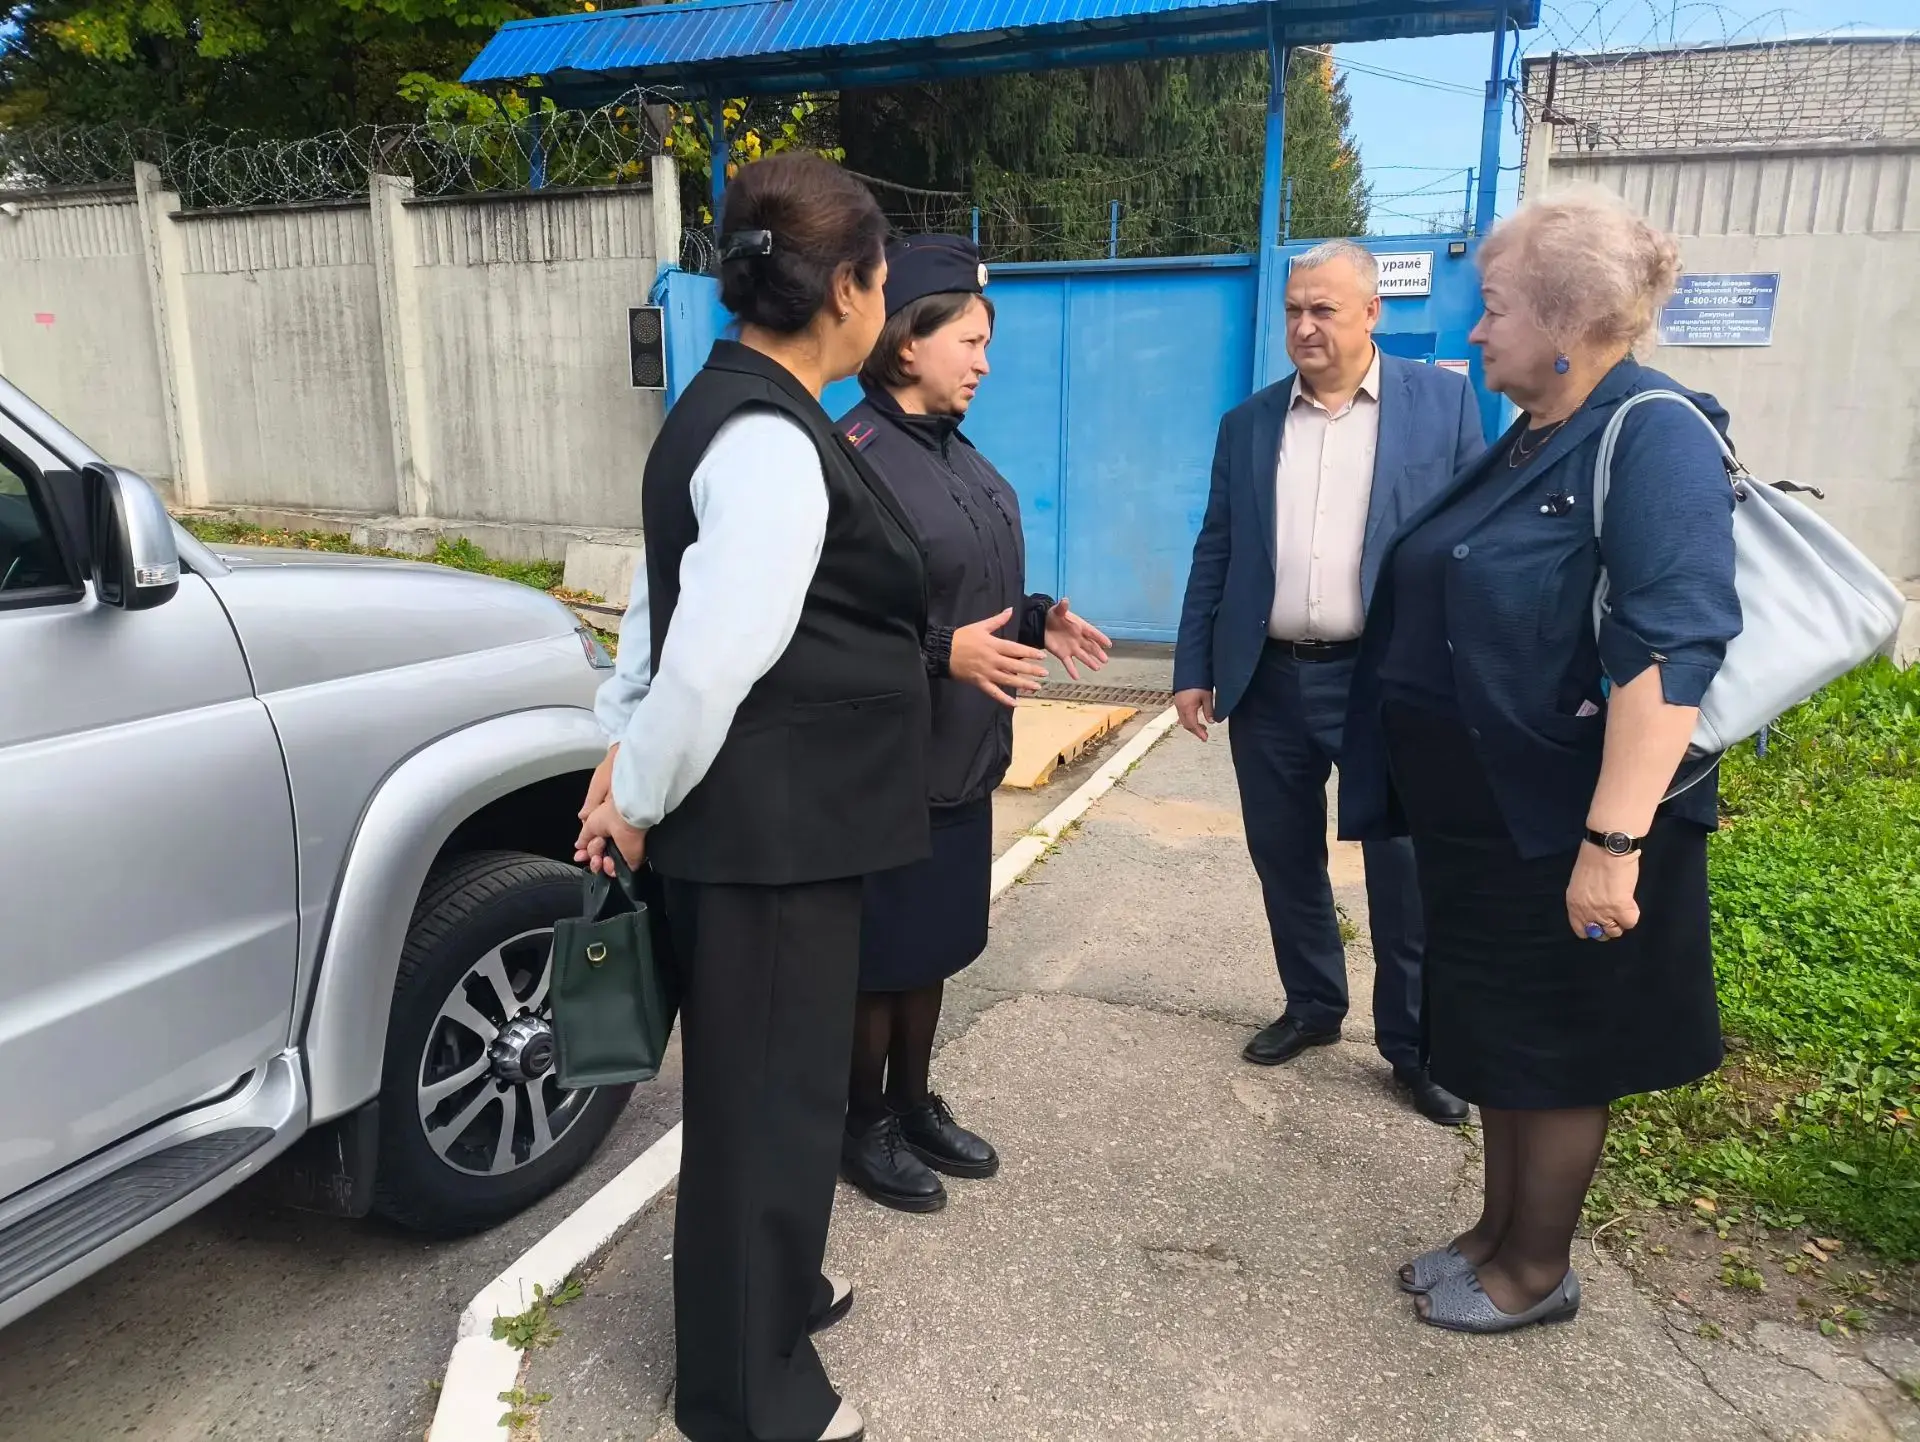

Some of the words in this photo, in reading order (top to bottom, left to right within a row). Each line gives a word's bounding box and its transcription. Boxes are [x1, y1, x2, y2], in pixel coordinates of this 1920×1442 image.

[1377, 278, 1427, 287] икитина
[1691, 280, 1720, 288] Телефон
[1721, 280, 1751, 288] доверия
